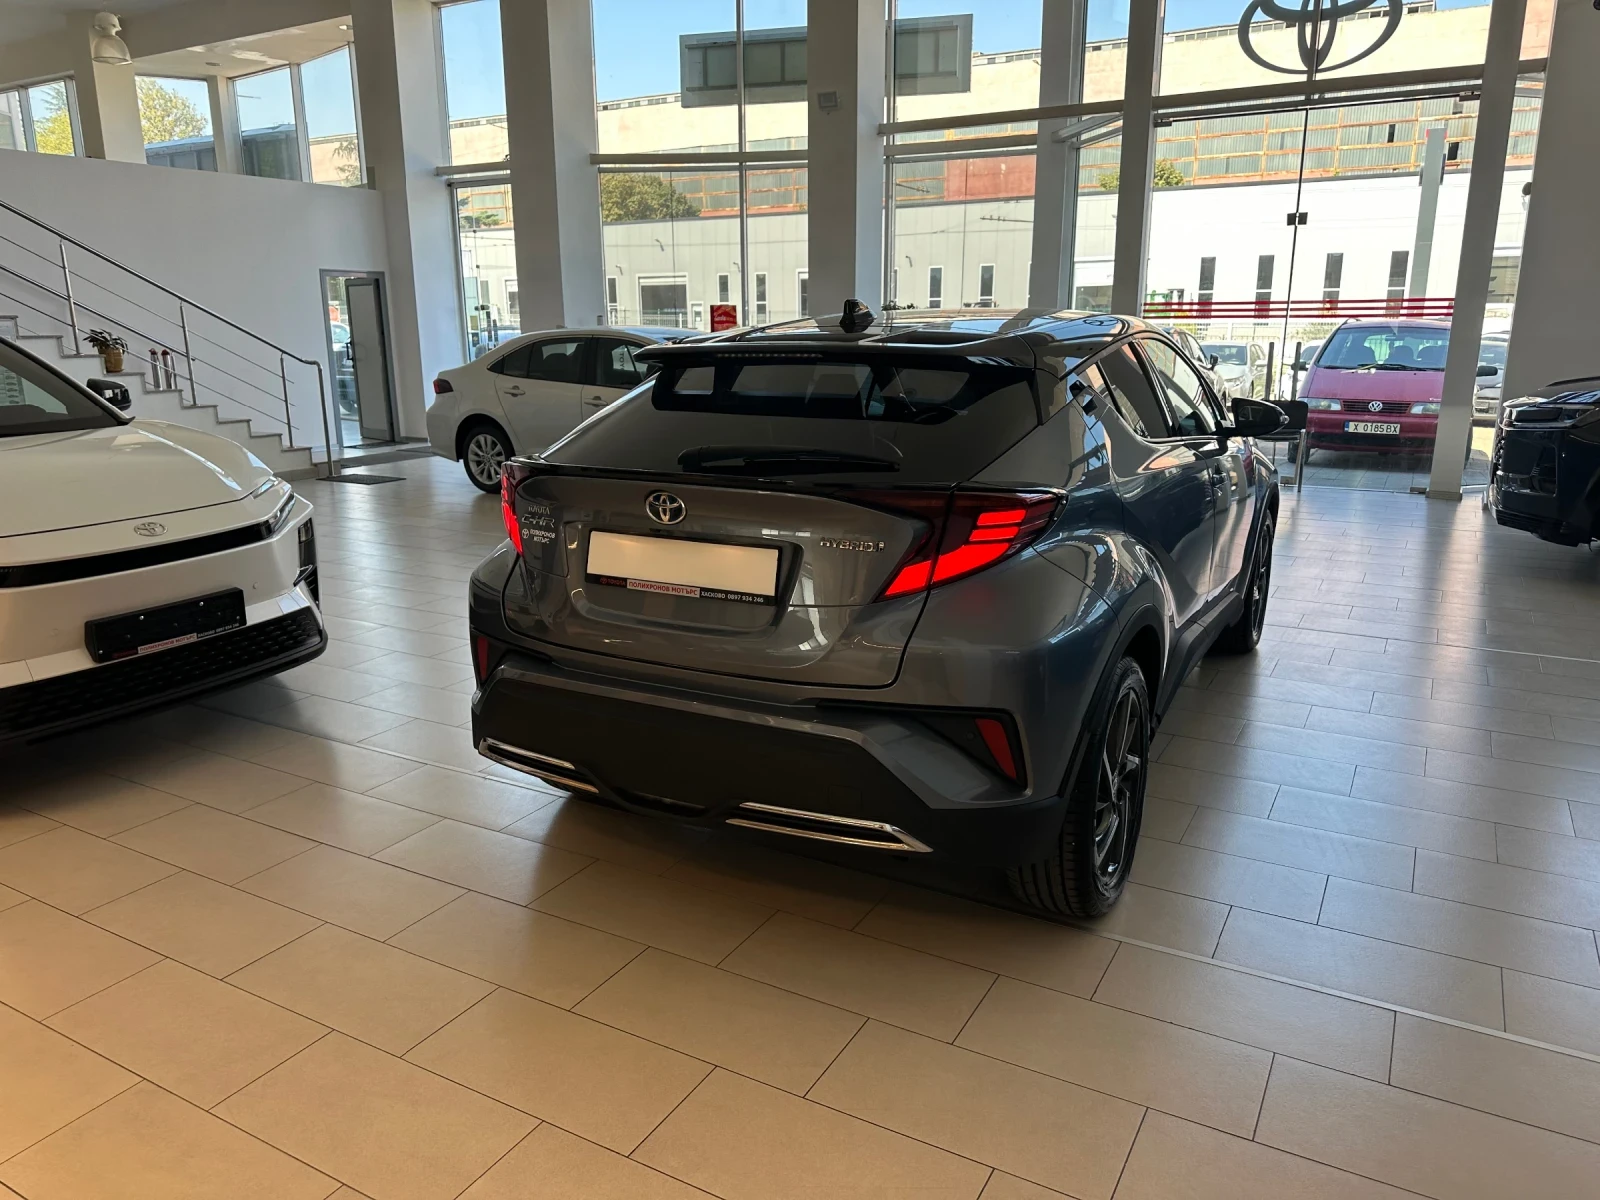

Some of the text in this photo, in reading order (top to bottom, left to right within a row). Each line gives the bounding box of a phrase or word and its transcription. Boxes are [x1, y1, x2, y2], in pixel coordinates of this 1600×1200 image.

[528, 504, 551, 515] TOYOTA
[521, 513, 555, 529] C-HR
[819, 537, 875, 552] HYBRID
[628, 581, 698, 596] ПОЛИХРОНОВ МОТЪРС
[701, 590, 726, 599] ХАСКОВО
